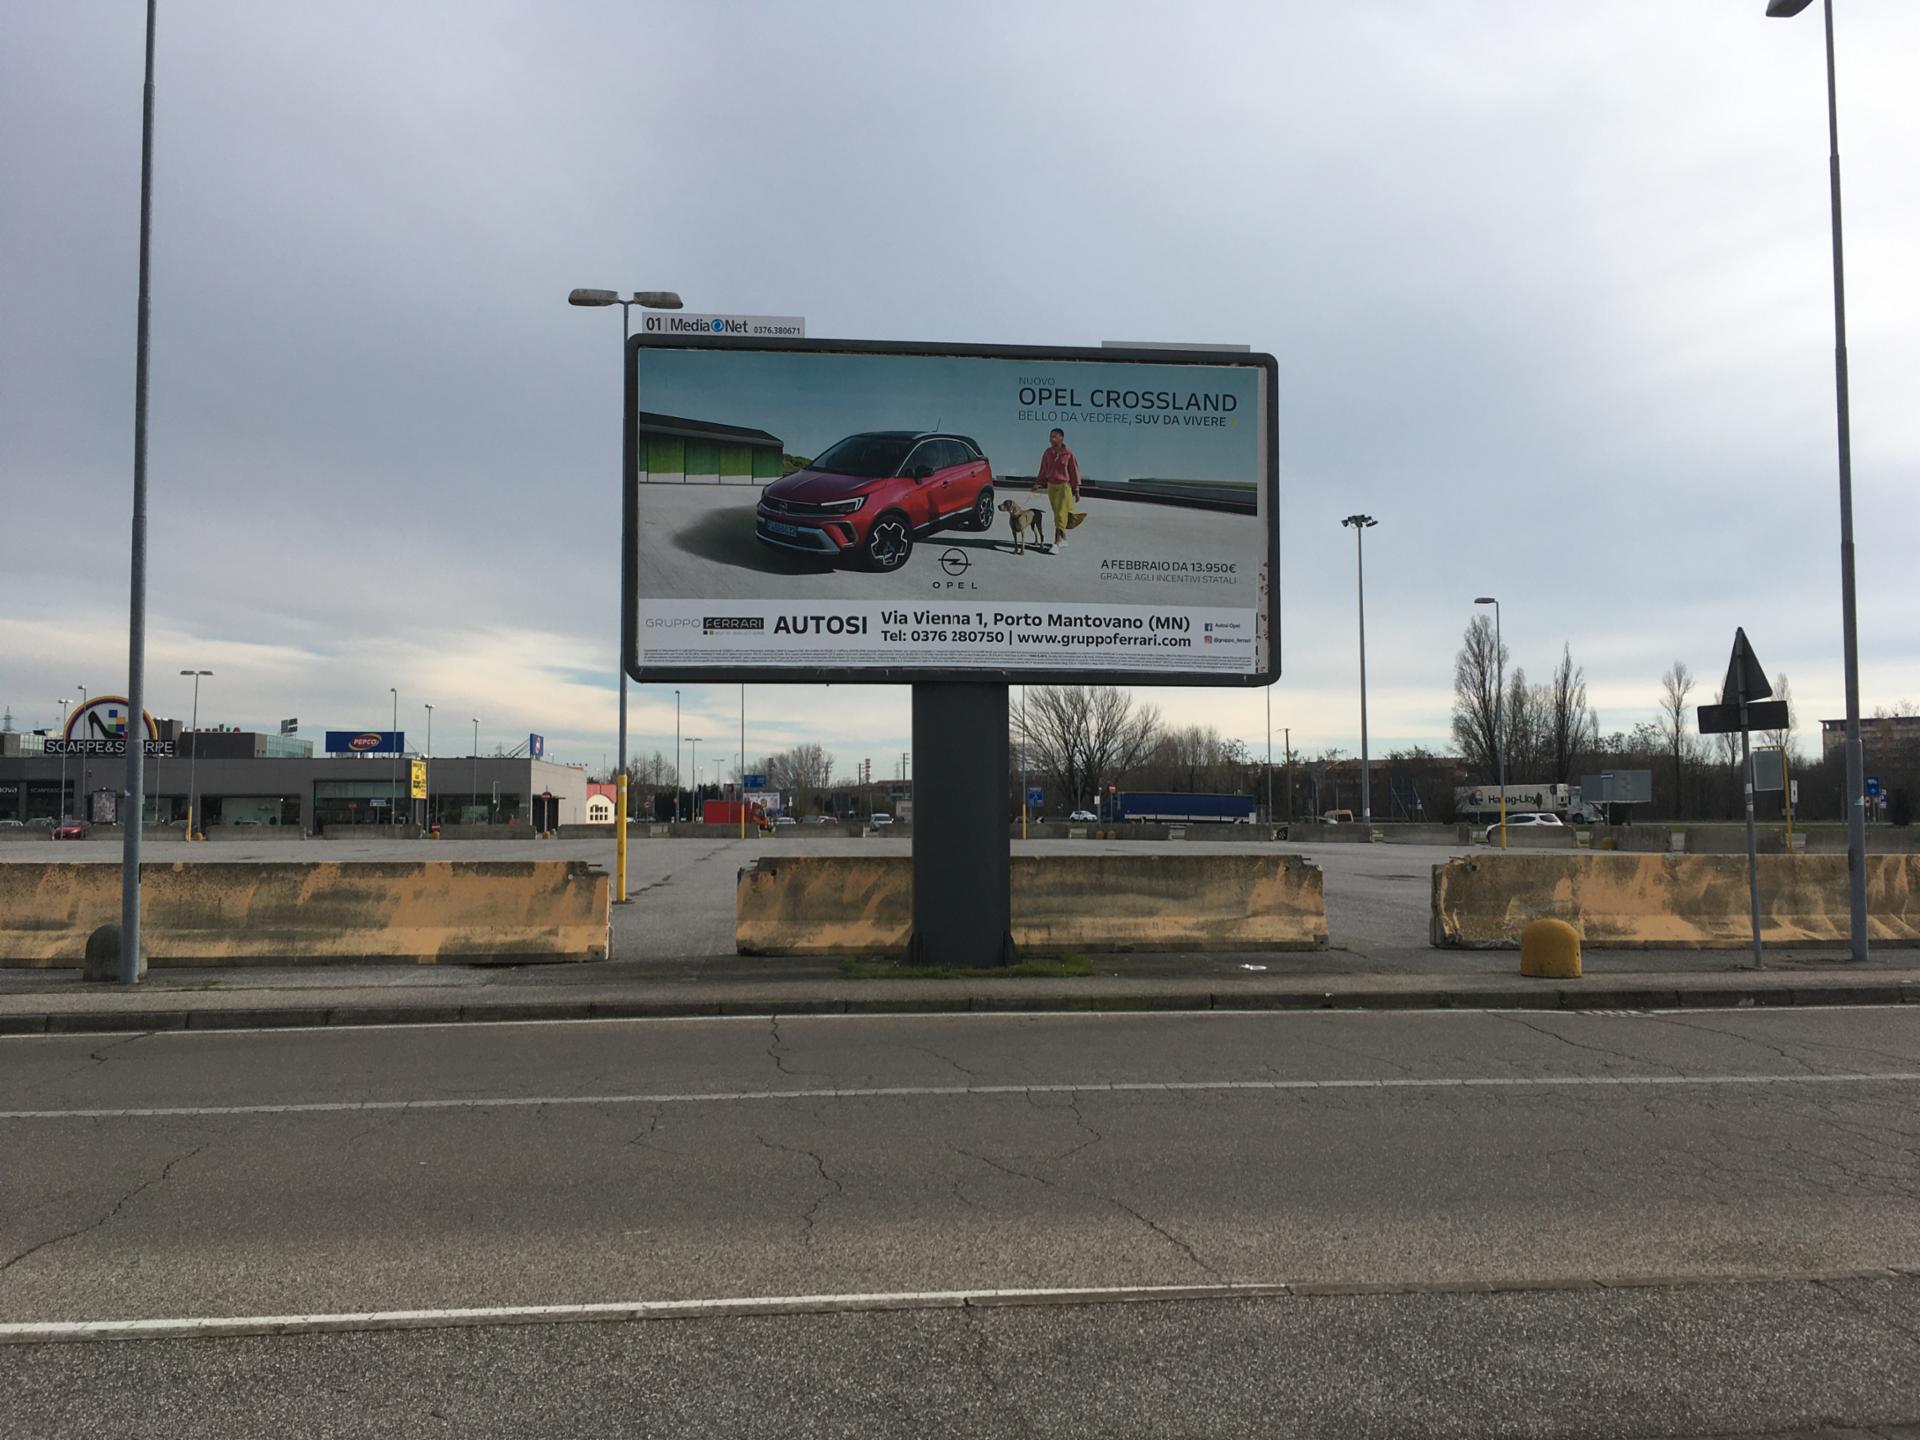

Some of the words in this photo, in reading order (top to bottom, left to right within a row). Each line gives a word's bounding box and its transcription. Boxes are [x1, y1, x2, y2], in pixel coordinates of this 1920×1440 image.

[646, 317, 661, 331] 01
[753, 326, 801, 335] 0376.380671
[1018, 377, 1056, 386] NUOVO
[1018, 387, 1082, 407] OPEL
[1090, 389, 1237, 412] CROSSLAND
[1018, 410, 1057, 422] BELLO
[1061, 412, 1078, 422] DA
[1080, 412, 1132, 425] VEDERE,
[1135, 414, 1160, 424] SUV
[1163, 415, 1180, 425] DA
[1183, 415, 1226, 427] VIVERE
[1101, 559, 1109, 569] A
[1111, 560, 1170, 571] FEBBRAIO
[1172, 561, 1188, 572] DA
[1190, 562, 1237, 573] 13.950€
[932, 581, 978, 590] OPEL
[1100, 572, 1132, 582] GRAZIE
[1134, 573, 1154, 582] AGLI
[1157, 574, 1200, 583] INCENTIVI
[1202, 575, 1236, 584] STATALI
[645, 618, 701, 628] GRUPPO
[705, 618, 763, 629] FERRARI
[773, 615, 868, 635] AUTOSI
[881, 610, 908, 625] Via
[913, 610, 970, 625] Vienna
[976, 612, 988, 628] 1,
[993, 612, 1042, 627] Porto
[1047, 614, 1143, 629] Mantovano
[1148, 615, 1191, 632] (MN)
[881, 630, 906, 642] Tel:
[911, 630, 947, 642] 0376
[951, 630, 1004, 643] 280750
[1017, 631, 1191, 648] www.gruppoferrari.com
[46, 741, 174, 753] SCARPE&SRPE
